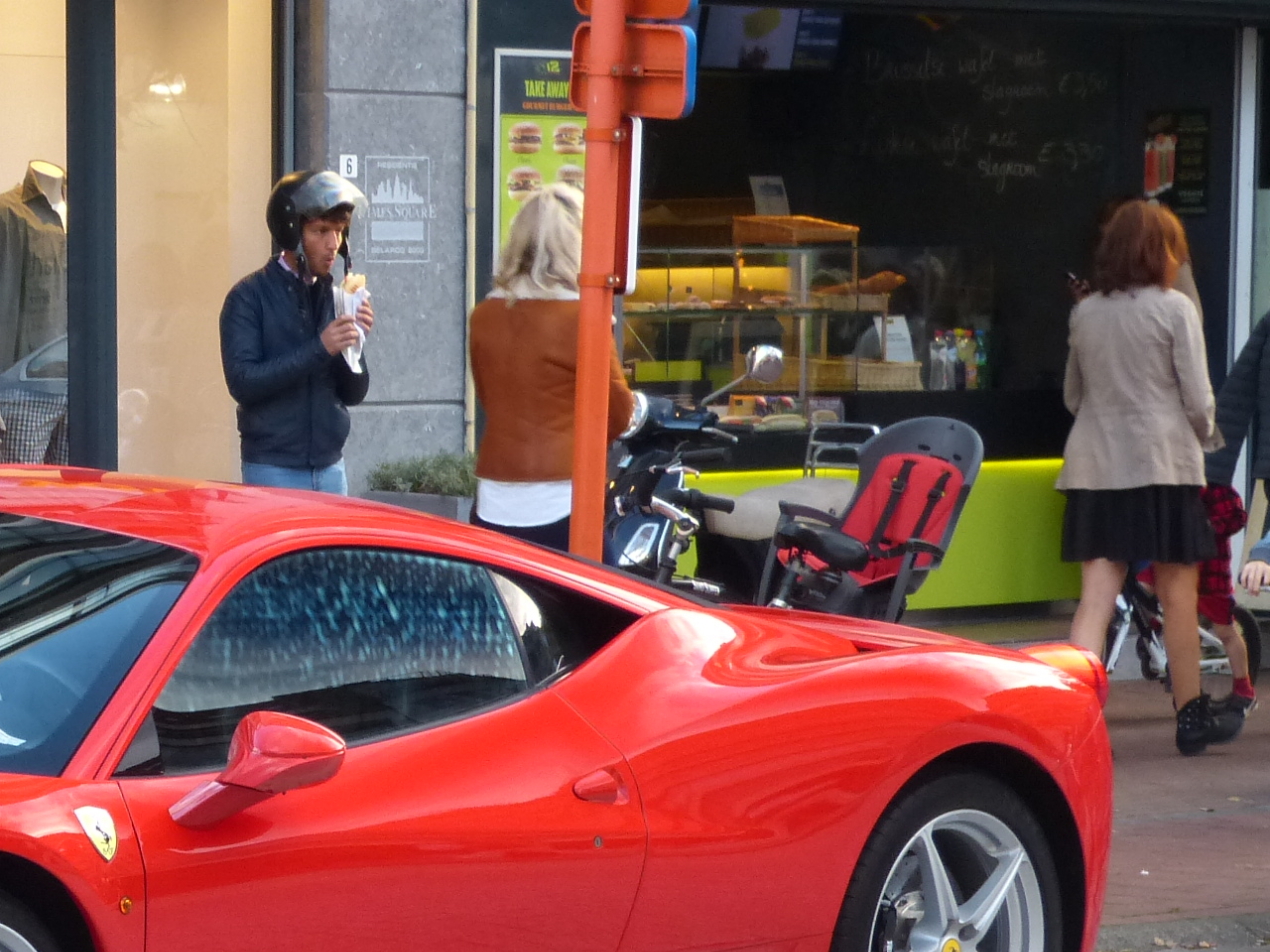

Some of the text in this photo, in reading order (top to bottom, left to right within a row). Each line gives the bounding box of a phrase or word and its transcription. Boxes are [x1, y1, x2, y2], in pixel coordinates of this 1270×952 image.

[525, 79, 570, 99] TAKE AWAY
[345, 157, 354, 175] 6
